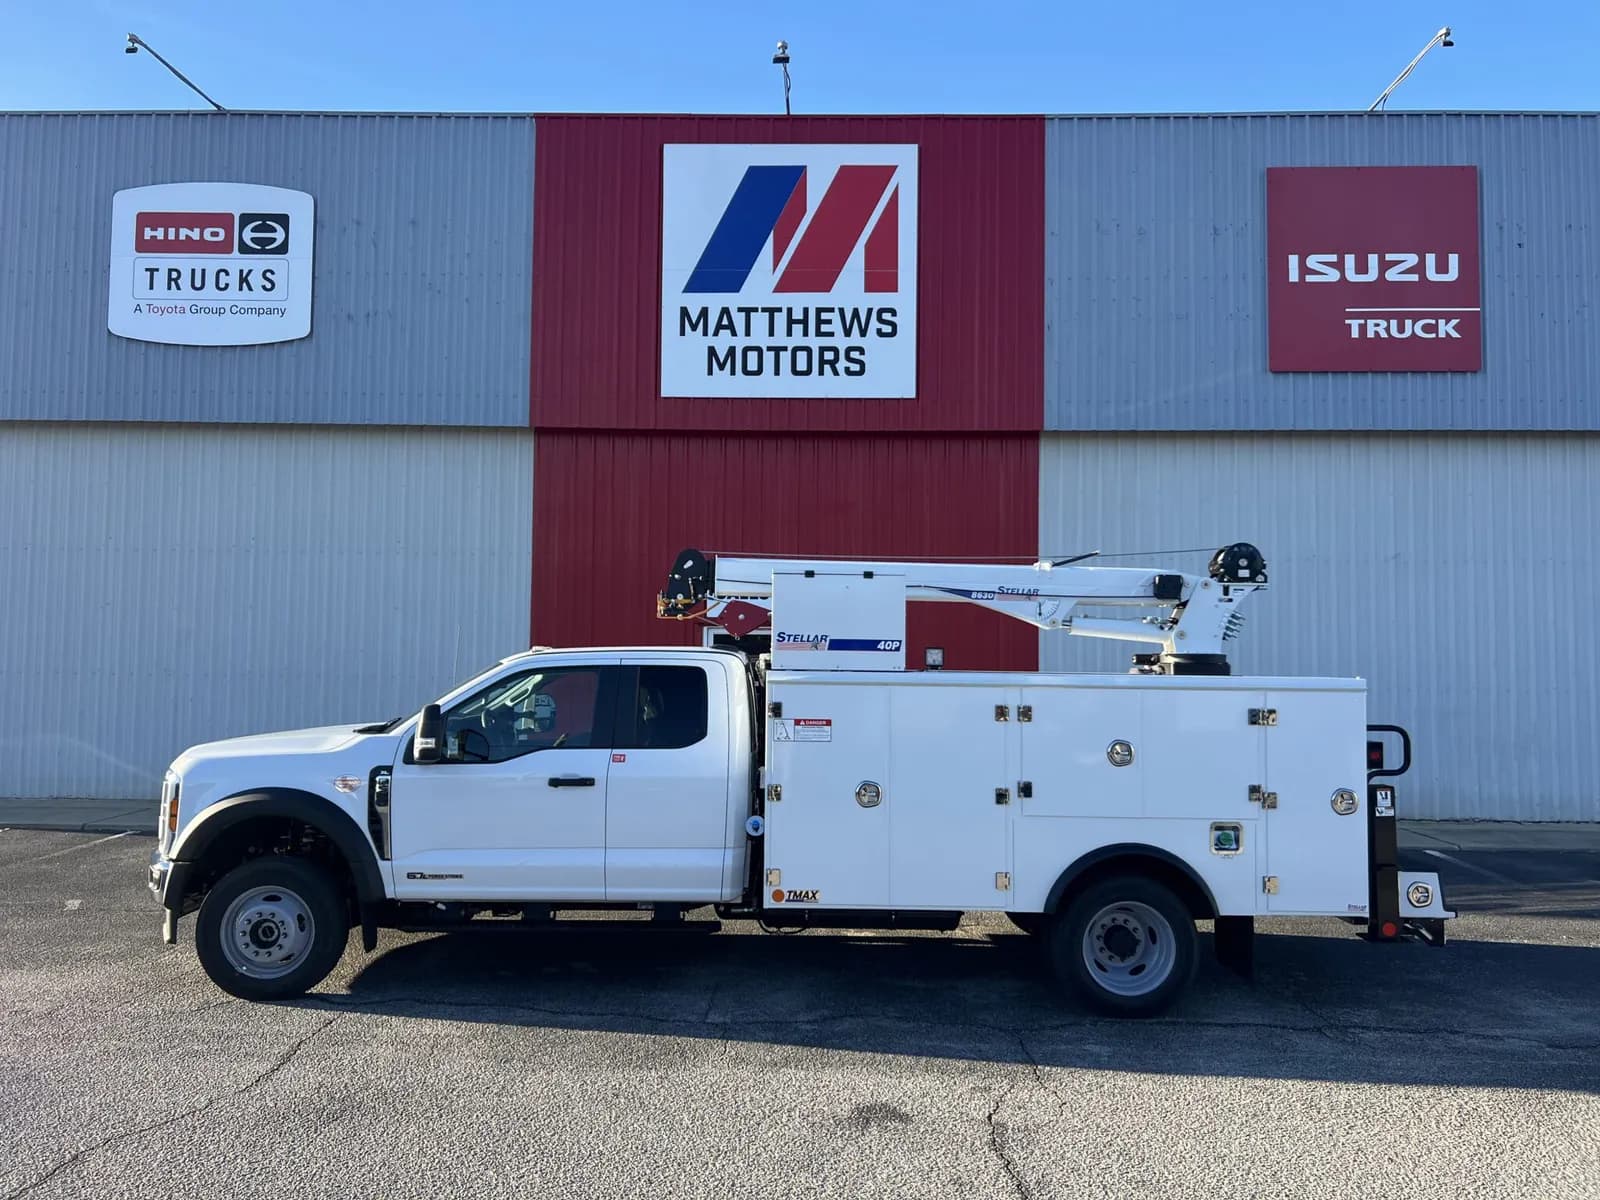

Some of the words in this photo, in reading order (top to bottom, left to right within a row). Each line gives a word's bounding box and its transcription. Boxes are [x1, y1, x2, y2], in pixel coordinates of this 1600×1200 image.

[143, 226, 226, 242] HINO
[1288, 253, 1459, 283] ISUZU
[144, 267, 277, 292] TRUCKS
[133, 303, 143, 314] A
[146, 303, 186, 316] Toyota
[189, 303, 226, 317] Group
[229, 304, 287, 318] Company
[679, 306, 898, 338] MATTHEWS
[1344, 318, 1462, 339] TRUCK
[707, 345, 866, 377] MOTORS
[997, 585, 1040, 596] STELLAR
[776, 631, 829, 643] STELLAR
[877, 640, 900, 650] 40P
[786, 890, 819, 900] TMAX
